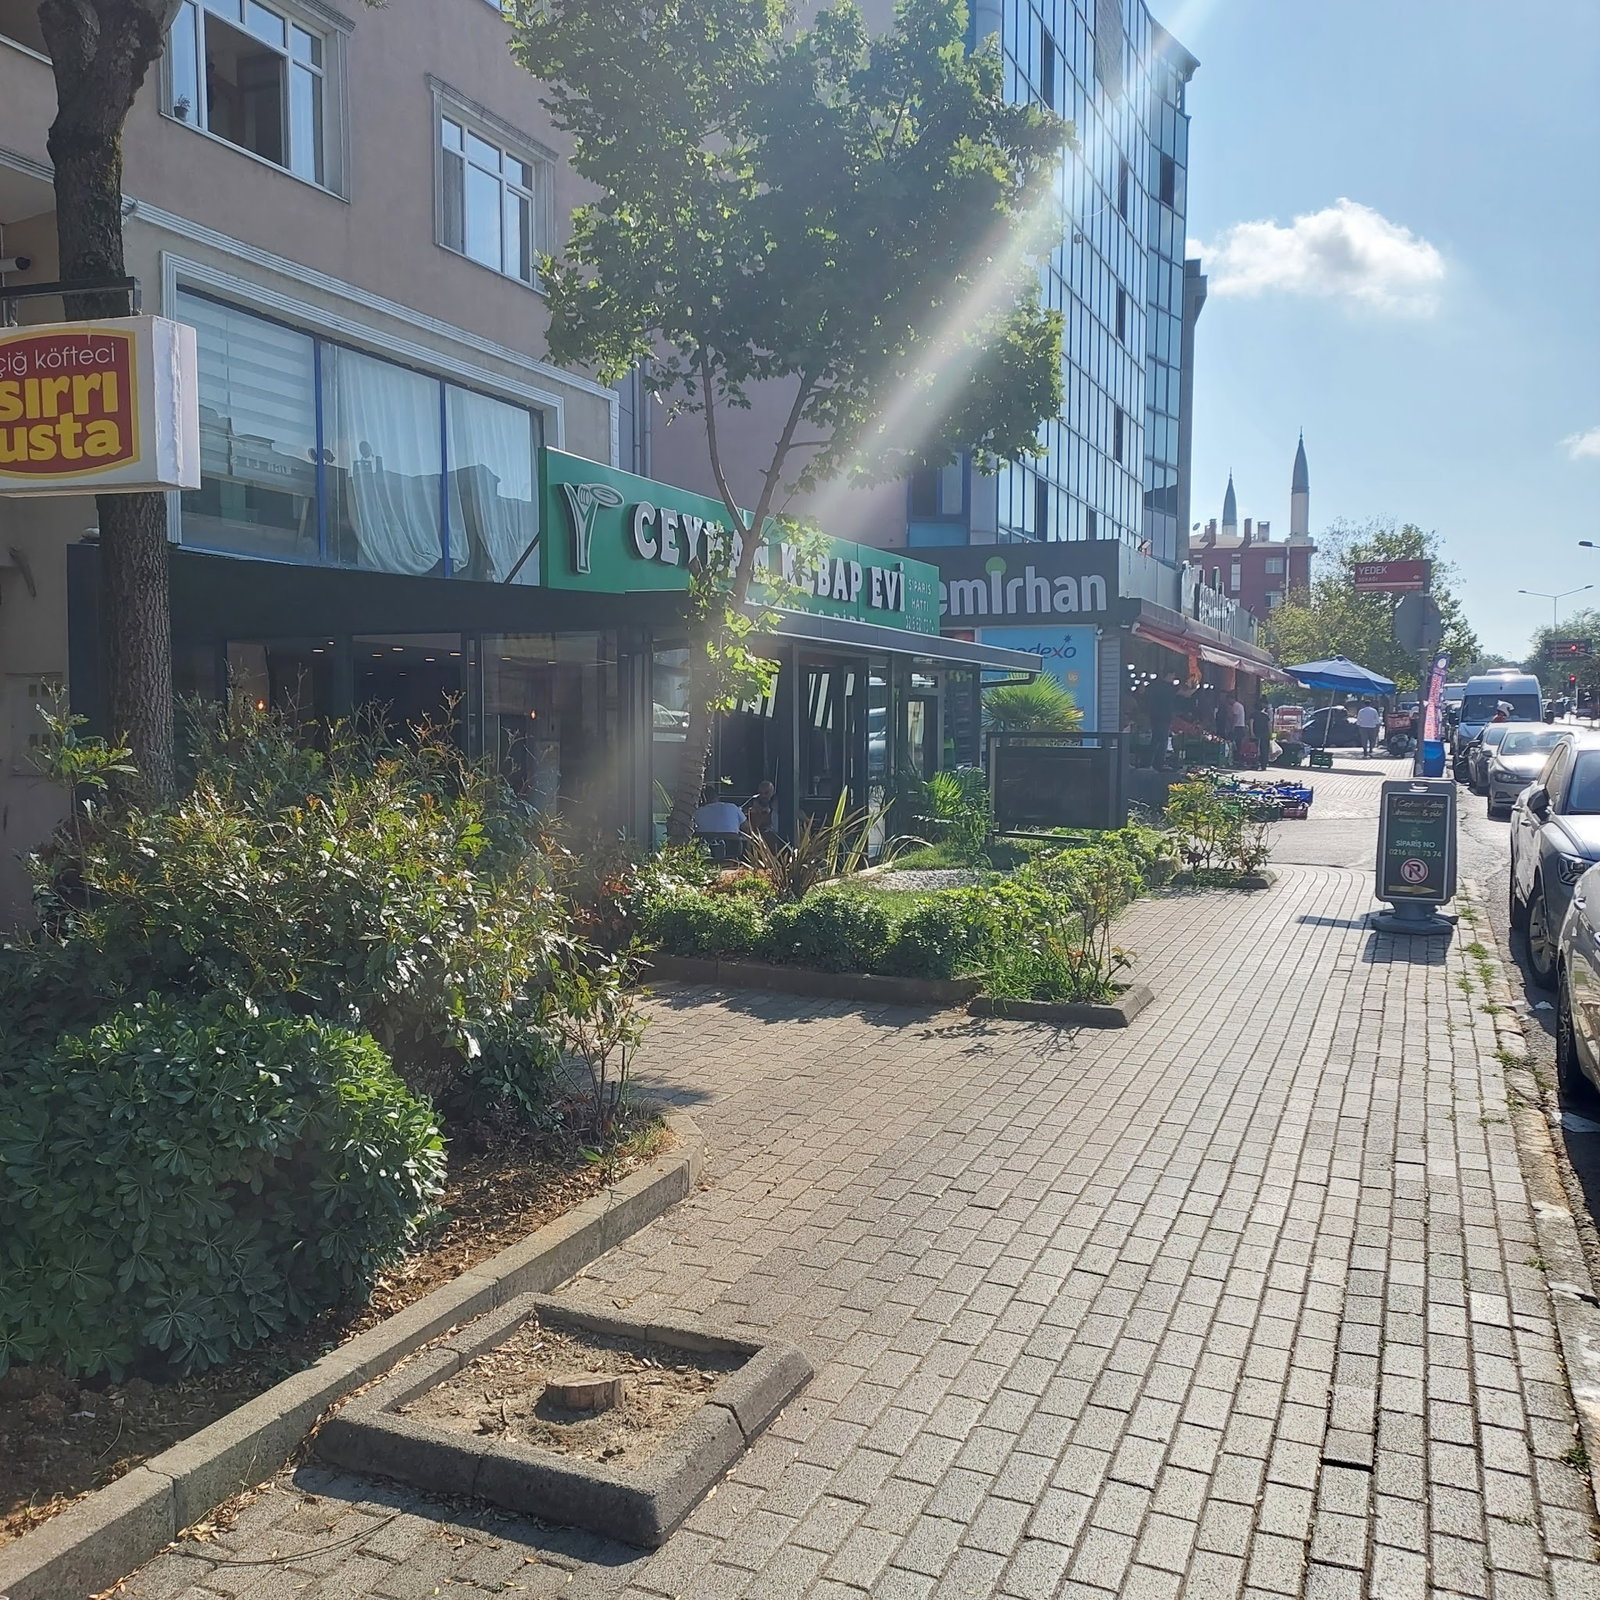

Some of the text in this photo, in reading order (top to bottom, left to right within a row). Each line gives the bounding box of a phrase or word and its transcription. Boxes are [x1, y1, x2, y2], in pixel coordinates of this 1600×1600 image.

[35, 342, 115, 370] köfteci
[0, 371, 119, 421] sırrı
[0, 412, 122, 463] usta
[871, 561, 905, 612] EVİ
[1359, 565, 1388, 575] YEDEK
[1009, 641, 1077, 659] dexo
